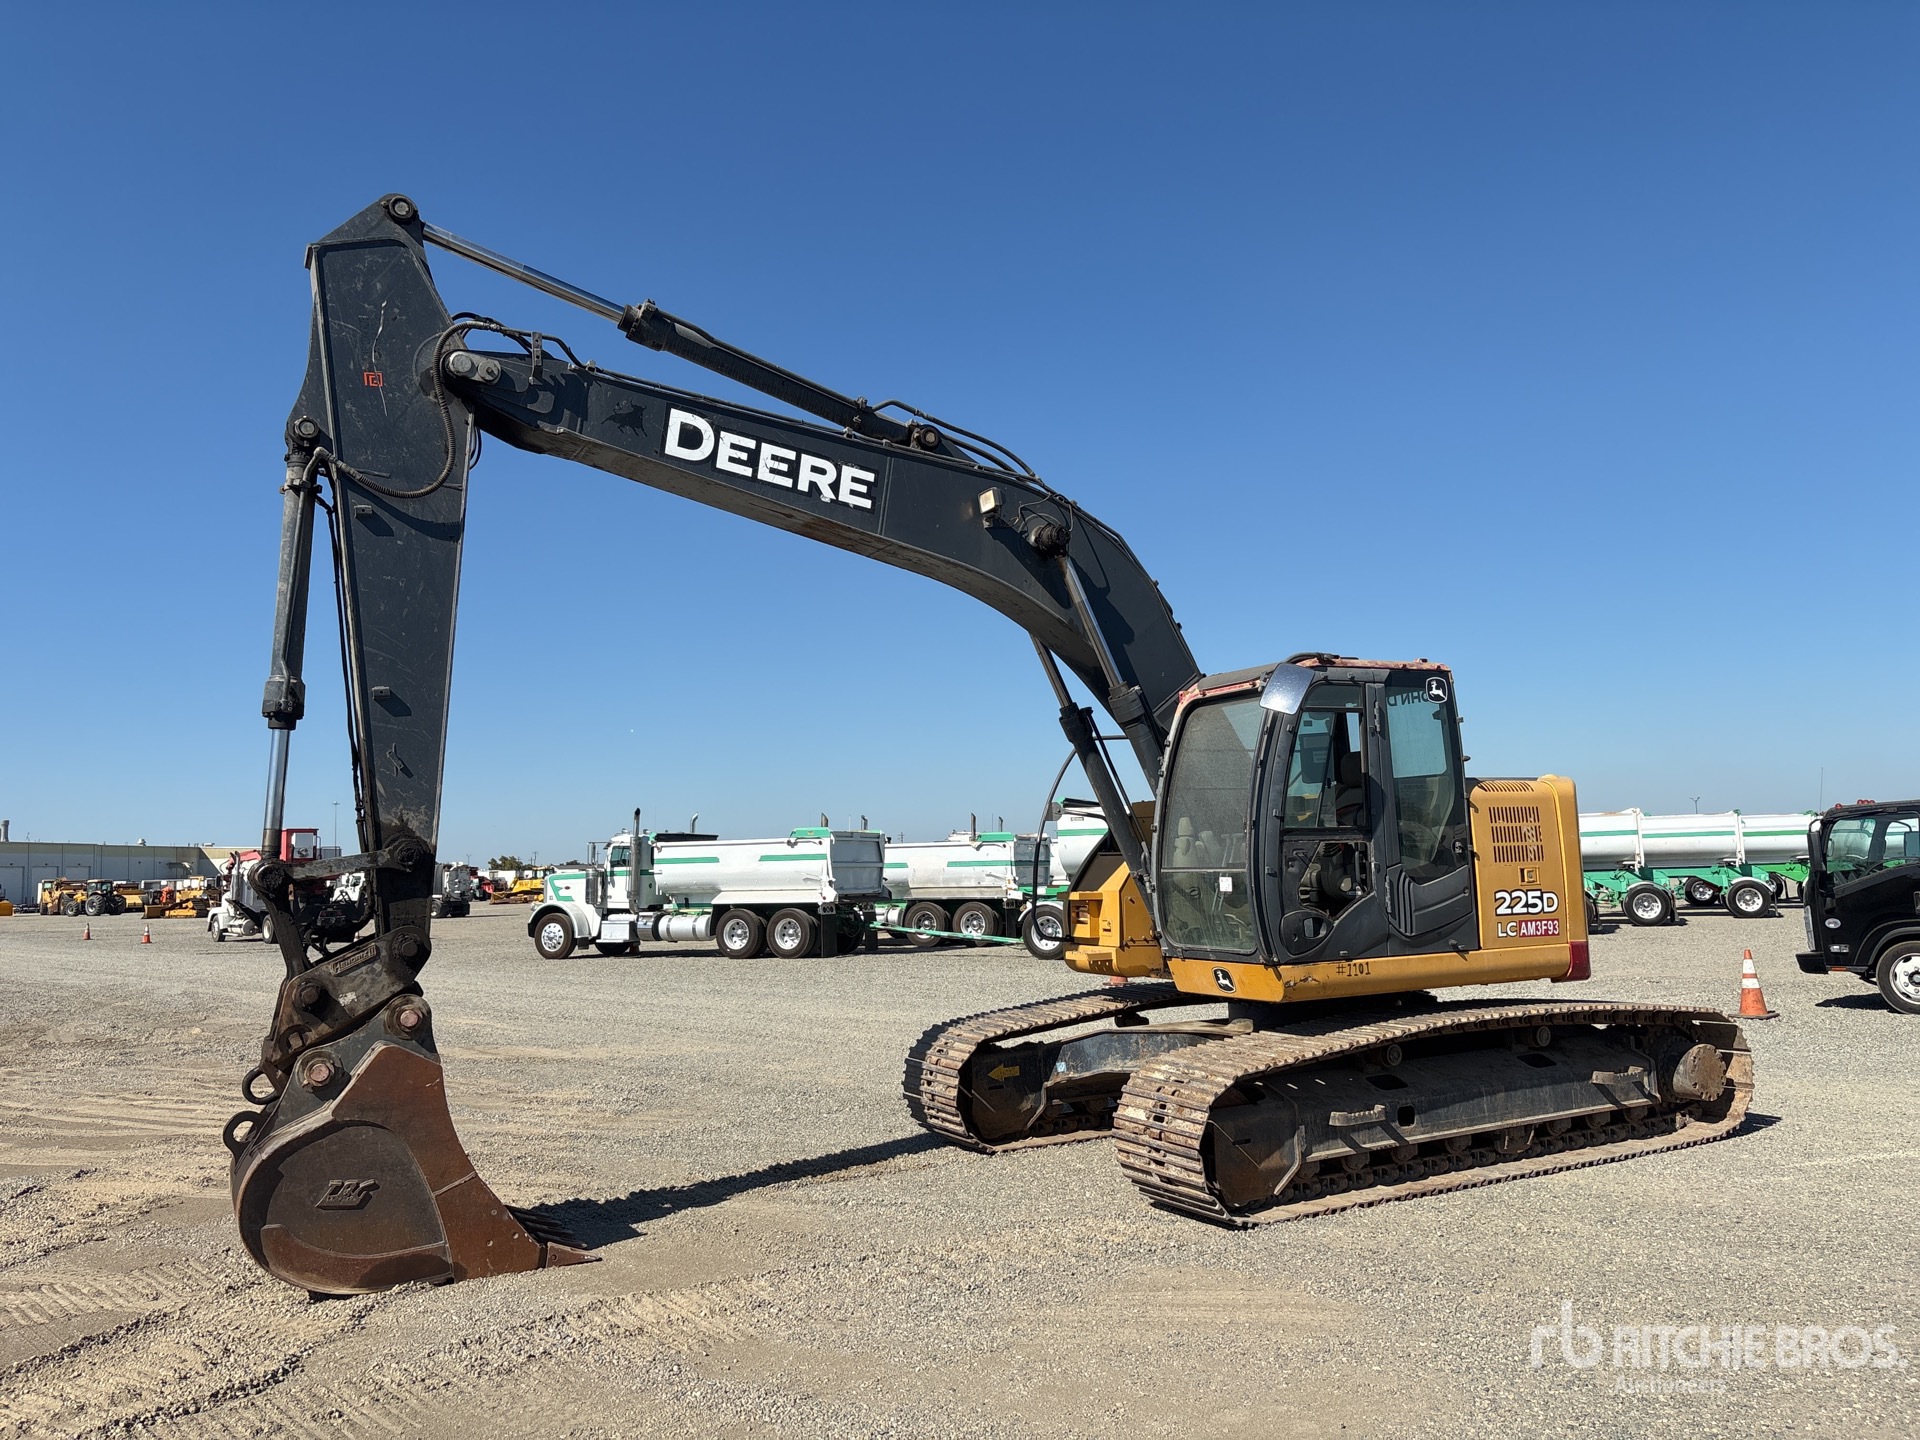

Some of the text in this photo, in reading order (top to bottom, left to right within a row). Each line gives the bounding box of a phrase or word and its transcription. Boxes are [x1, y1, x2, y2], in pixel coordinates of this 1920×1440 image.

[664, 407, 876, 510] DEERE
[1494, 889, 1559, 916] 225D
[1497, 920, 1559, 938] LC AM3F93
[1336, 961, 1371, 977] #1101
